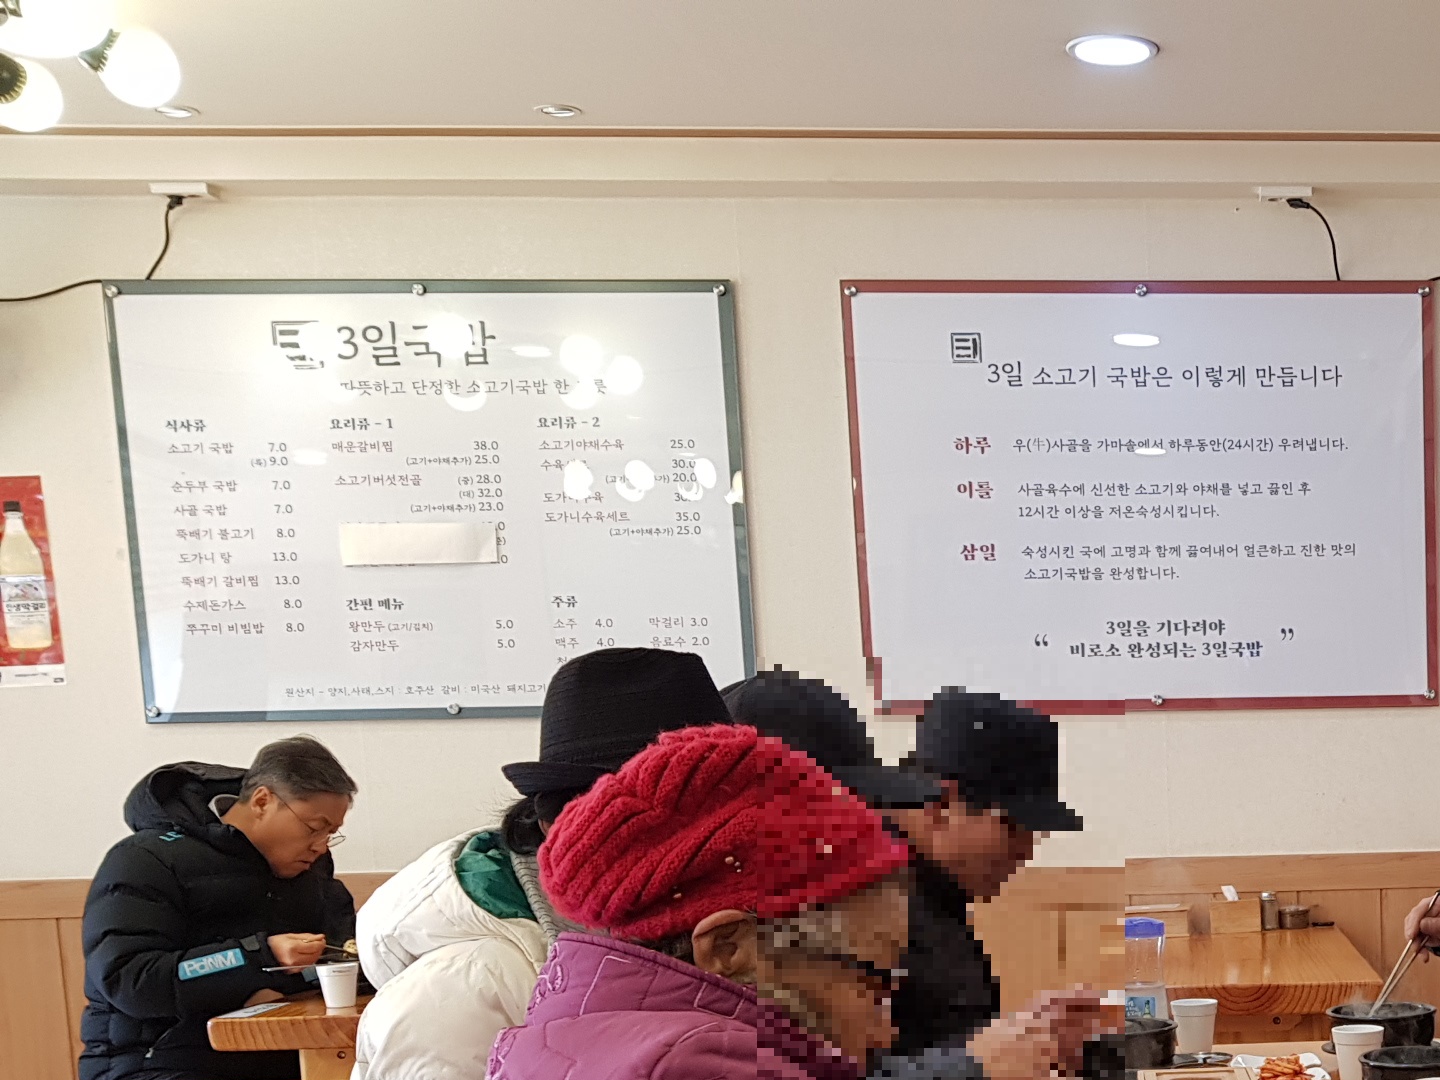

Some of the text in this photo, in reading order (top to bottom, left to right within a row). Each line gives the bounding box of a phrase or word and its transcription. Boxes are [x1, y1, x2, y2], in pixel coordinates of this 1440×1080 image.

[336, 320, 496, 368] 3일국밥
[987, 361, 1343, 388] 3일 소고기 국밥은 이렇게 만듭니다
[412, 378, 461, 395] 단정한
[467, 378, 549, 395] 소고기국밥
[553, 378, 570, 395] 한
[165, 418, 206, 432] 식사류
[329, 417, 370, 430] 요리류
[537, 416, 577, 429] 요리류
[168, 442, 287, 454] 소고기 국밥 7.0
[331, 440, 499, 453] 매운갈비찜 38.0
[538, 439, 695, 451] 소고기야채수육 25.0
[953, 436, 992, 455] 하루
[1168, 437, 1274, 453] 하루동안(24시간)
[1278, 437, 1349, 453] 우려냅니다.
[269, 456, 288, 466] 9.0
[474, 454, 500, 464] 25.0
[334, 474, 422, 486] 소고기버섯전골
[476, 474, 501, 484] 28.0
[672, 473, 697, 482] 20.0
[212, 480, 238, 492] 국밥
[272, 480, 291, 490] 7.0
[1018, 482, 1085, 497] 사골육수에
[1091, 482, 1130, 497] 신선한
[1134, 482, 1188, 497] 소고기와
[1192, 481, 1232, 496] 야채를
[1237, 482, 1263, 496] 넣고
[1267, 481, 1294, 496] 끓인
[1297, 481, 1311, 496] 후
[477, 488, 502, 498] 32.0
[174, 504, 293, 516] 사골 국밥 7.0
[478, 502, 504, 511] 23.0
[1018, 504, 1220, 519] 12시간 이상을 저온숙성시킵니다.
[544, 511, 700, 523] 도가니수육세트 35.0
[176, 528, 295, 540] 뚝배기 불고기 8.0
[676, 526, 701, 535] 25.0
[178, 552, 298, 564] 도가니 탕 13.0
[960, 543, 1357, 561] 삼일 숙성시킨 국에 고명과 함께 끓여내어 얼큰하고 진한 맛의
[1024, 566, 1180, 581] 소고기국밥을 완성합니다.
[181, 575, 300, 588] 뚝배기 갈비찜 13.0
[183, 599, 303, 611] 수제돈가스 8.0
[345, 598, 404, 611] 간편 메뉴
[551, 595, 578, 608] 주류
[227, 622, 265, 635] 비빔밥
[286, 622, 305, 632] 8.0
[349, 621, 385, 633] 왕만두
[495, 619, 513, 629] 5.0
[553, 616, 708, 630] 소주 4.0 막걸리 3.0
[1106, 618, 1226, 637] 3일을 기다려야
[350, 639, 515, 652] 감자만두 5.0
[555, 636, 710, 649] 맥주 4.0 음료수 2.0
[1069, 640, 1263, 659] 비로소 완성되는 3일국밥
